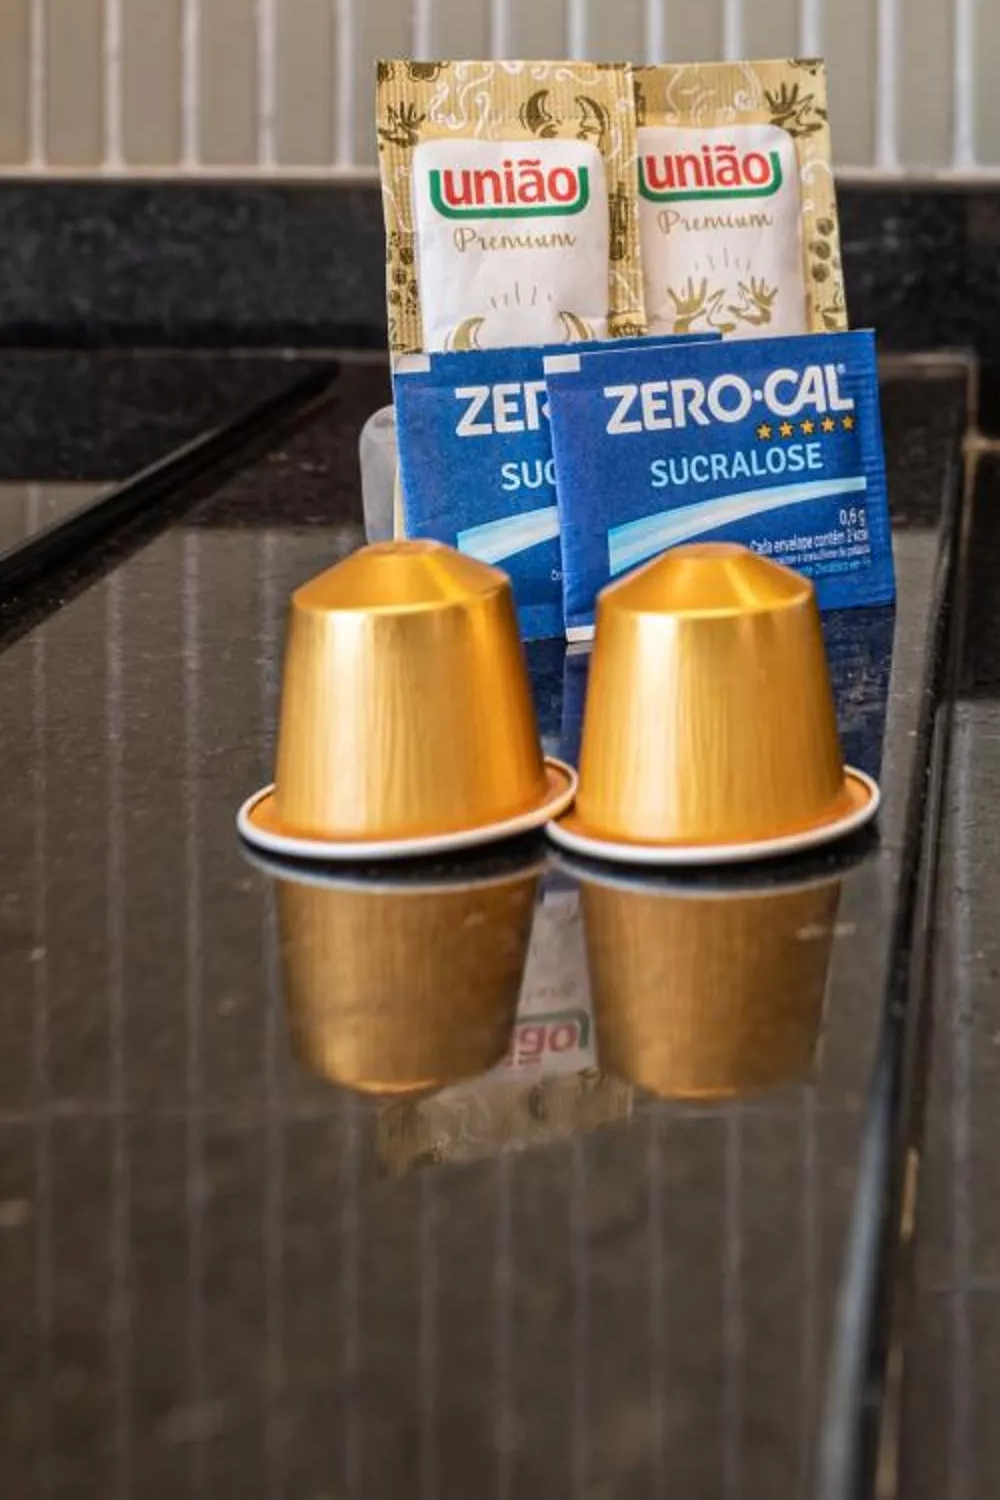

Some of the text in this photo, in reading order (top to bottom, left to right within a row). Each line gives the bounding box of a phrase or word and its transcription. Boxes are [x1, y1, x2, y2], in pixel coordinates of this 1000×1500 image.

[443, 159, 577, 206] união
[646, 144, 770, 190] união
[453, 226, 577, 253] Premium
[657, 208, 774, 233] Premium
[651, 442, 824, 488] SUCRALOSE
